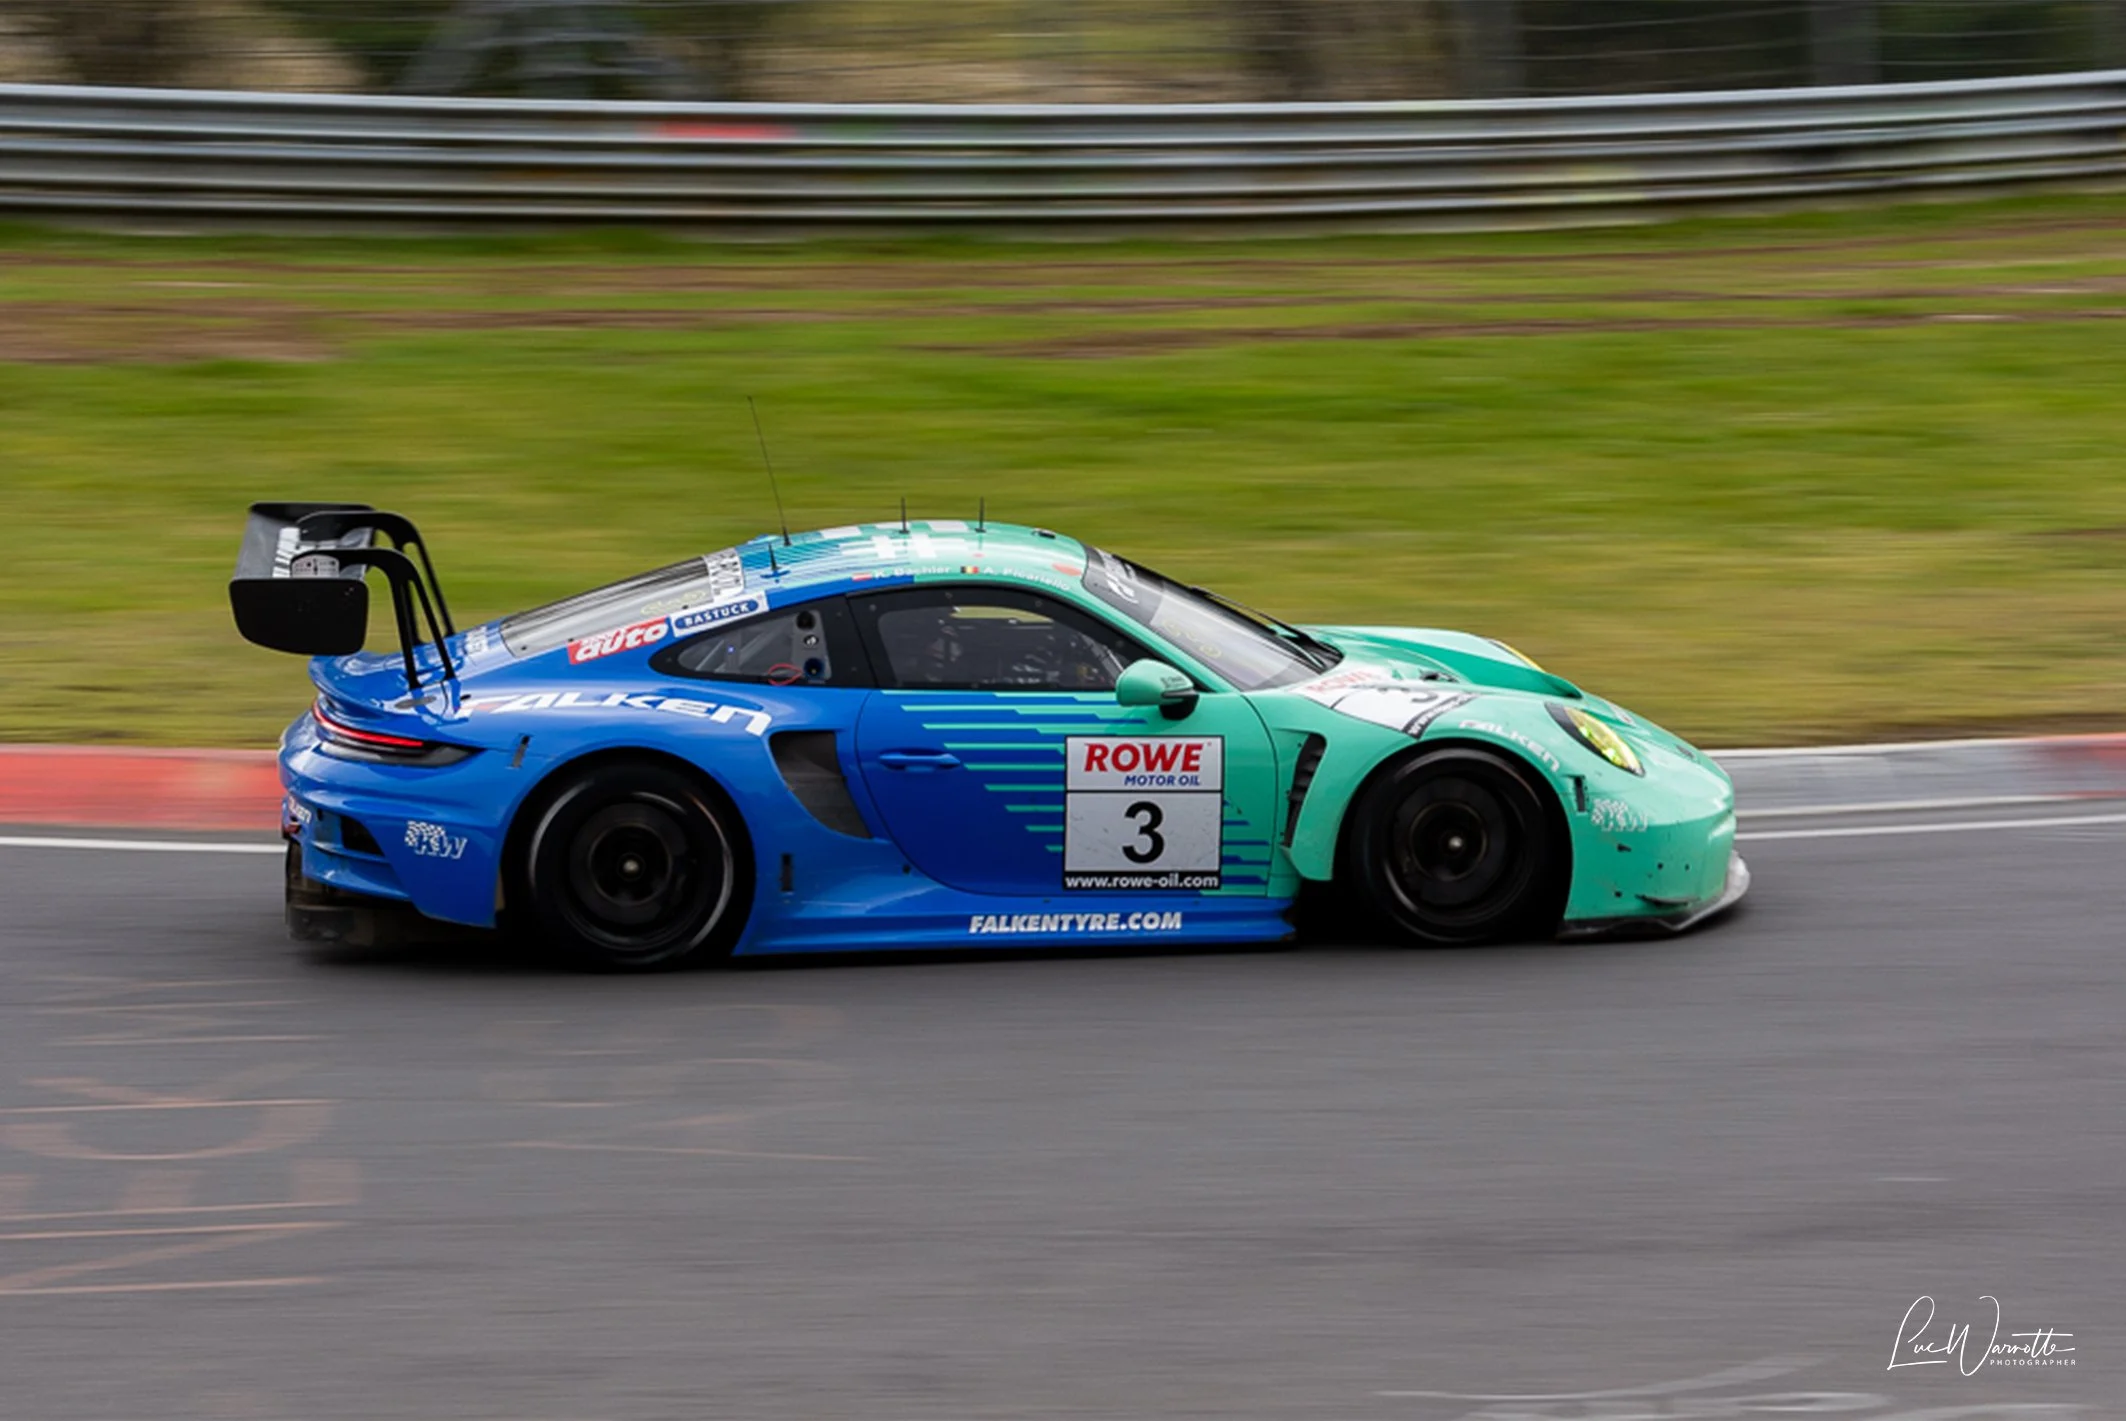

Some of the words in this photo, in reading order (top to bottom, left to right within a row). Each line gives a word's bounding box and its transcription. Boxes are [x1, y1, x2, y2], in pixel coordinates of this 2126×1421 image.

[684, 602, 751, 628] BASTUCK
[1083, 742, 1204, 773] ROWE
[1124, 775, 1175, 786] MOTOR
[1178, 775, 1201, 786] OIL
[1122, 801, 1165, 865] 3
[1066, 873, 1220, 888] www.rowe-oil.com
[968, 912, 1182, 934] FALKENTYRE.COM
